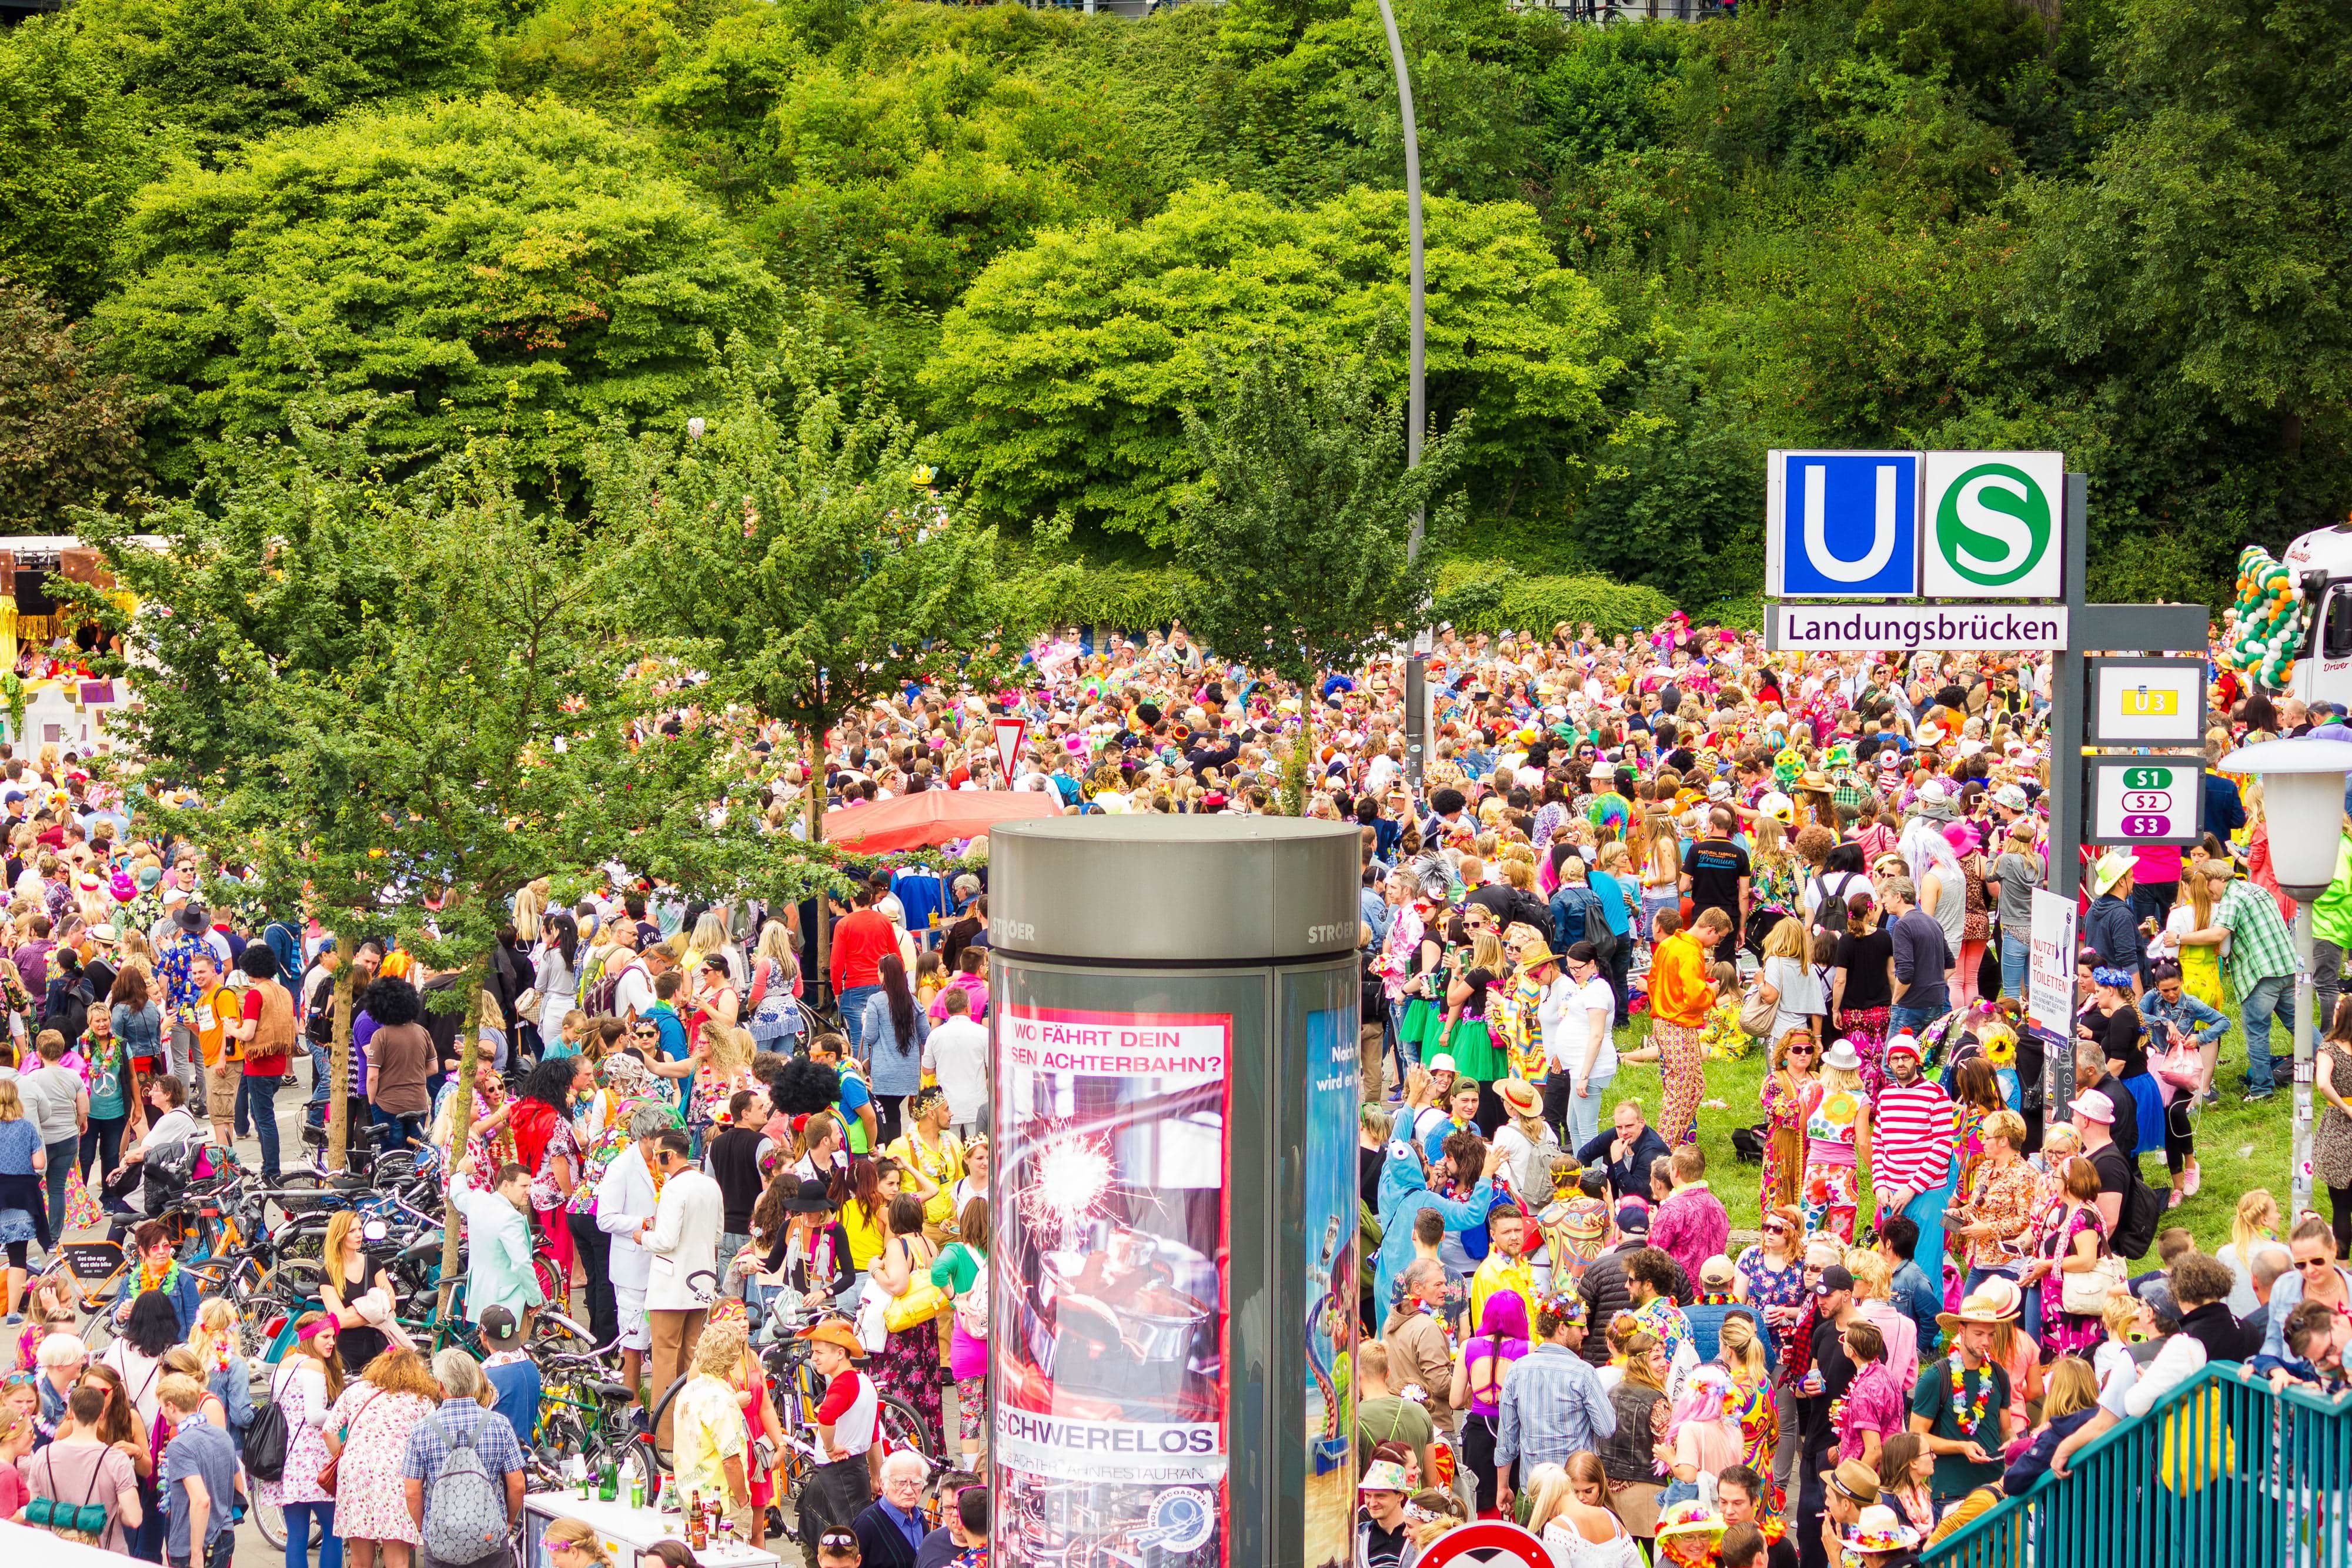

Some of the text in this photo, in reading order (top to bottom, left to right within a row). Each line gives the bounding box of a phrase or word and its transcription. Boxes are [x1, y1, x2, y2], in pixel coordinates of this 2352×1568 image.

[1804, 465, 1897, 582] U
[1956, 474, 2033, 575] S
[1788, 613, 2058, 647] Landungsbrücken
[2324, 661, 2348, 671] Driver
[1699, 853, 1736, 866] Premium
[993, 917, 1035, 941] STRÖER
[1308, 921, 1354, 944] STRÖER
[2033, 938, 2055, 957] NUTZT
[2033, 954, 2043, 968] DIE
[2033, 969, 2068, 994] TOILETTEN!
[1014, 1022, 1180, 1048] WO FÄHRT DEIN
[1043, 1052, 1221, 1072] ACHTERBAHN?
[1332, 1042, 1354, 1062] Nach
[1316, 1071, 1342, 1092] wird
[997, 1409, 1214, 1453] SCHWERELOS
[1151, 1490, 1207, 1527] ROLLERCOASTER
